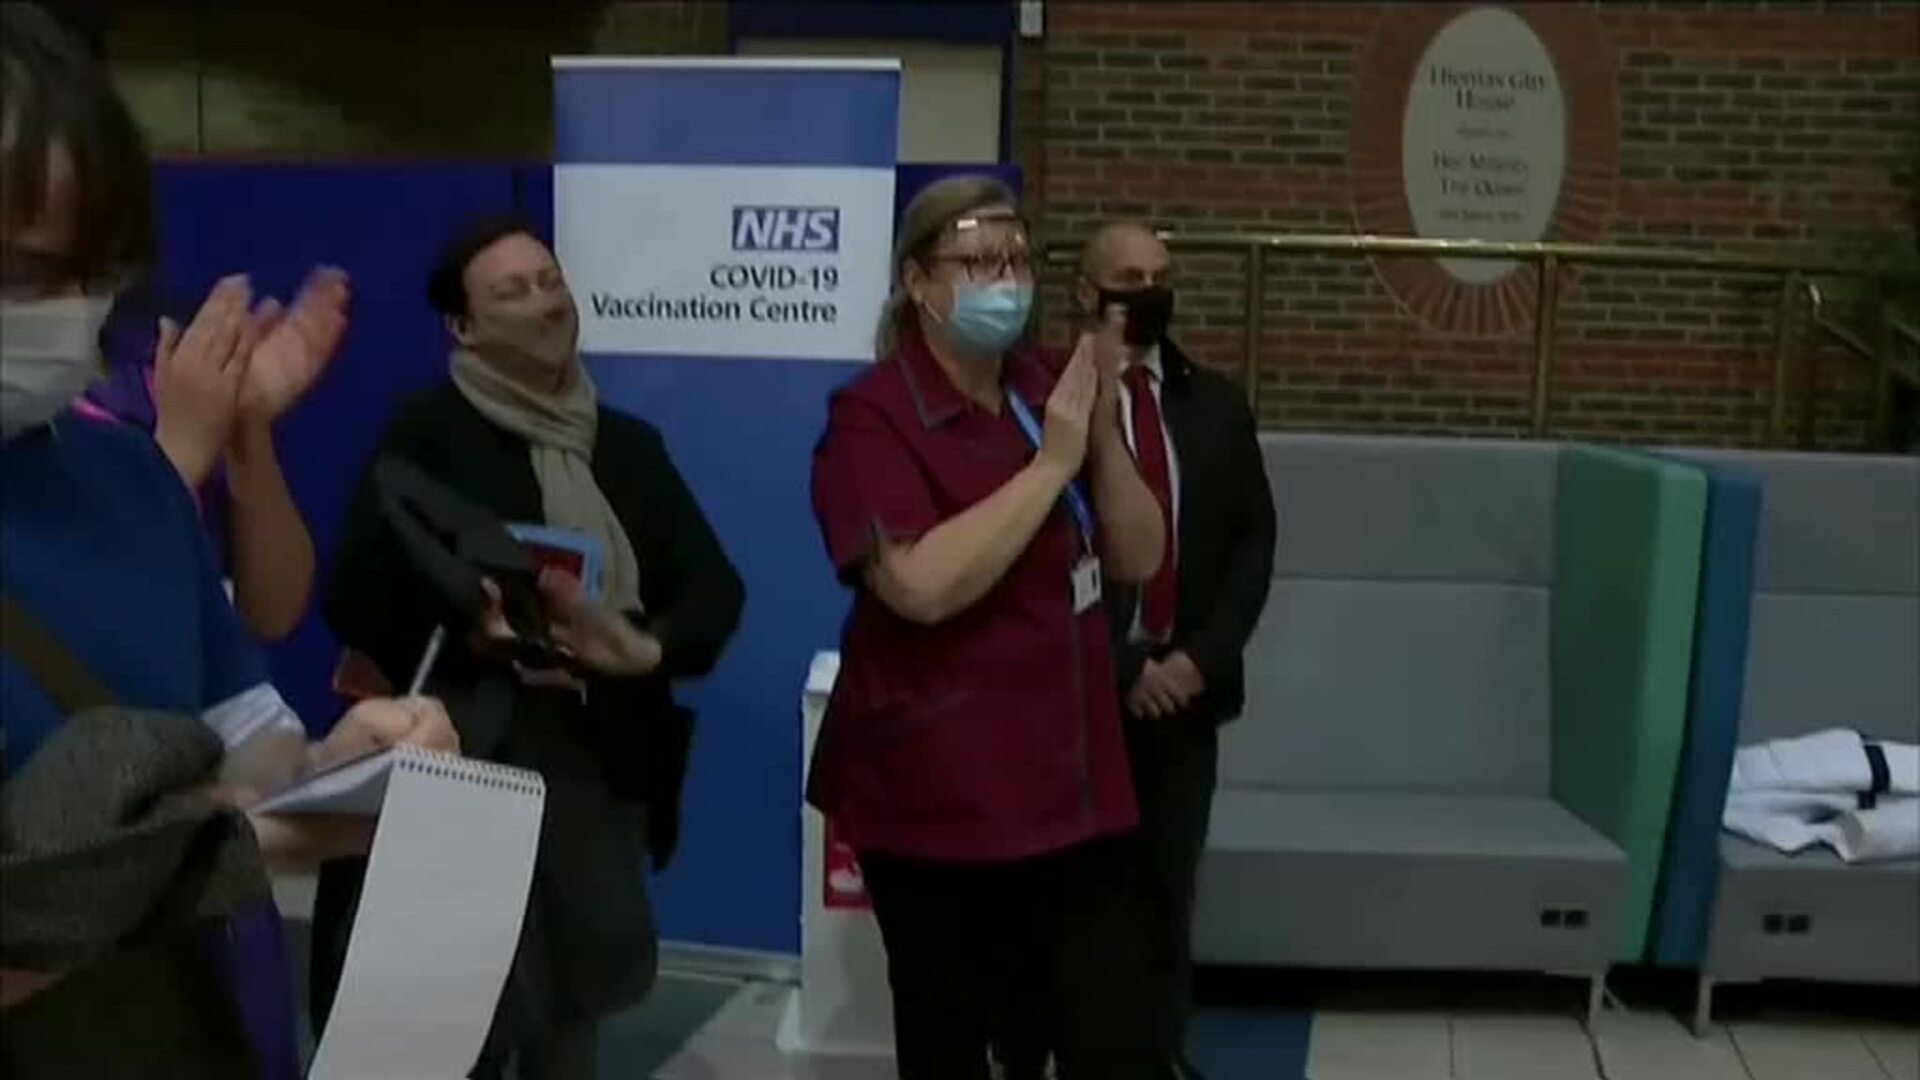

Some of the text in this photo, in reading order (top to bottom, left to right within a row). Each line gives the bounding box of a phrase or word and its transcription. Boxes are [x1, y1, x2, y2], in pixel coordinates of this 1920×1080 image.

[735, 208, 836, 249] NHS
[710, 265, 839, 290] COVID-19
[591, 293, 838, 323] Vaccination Centre
